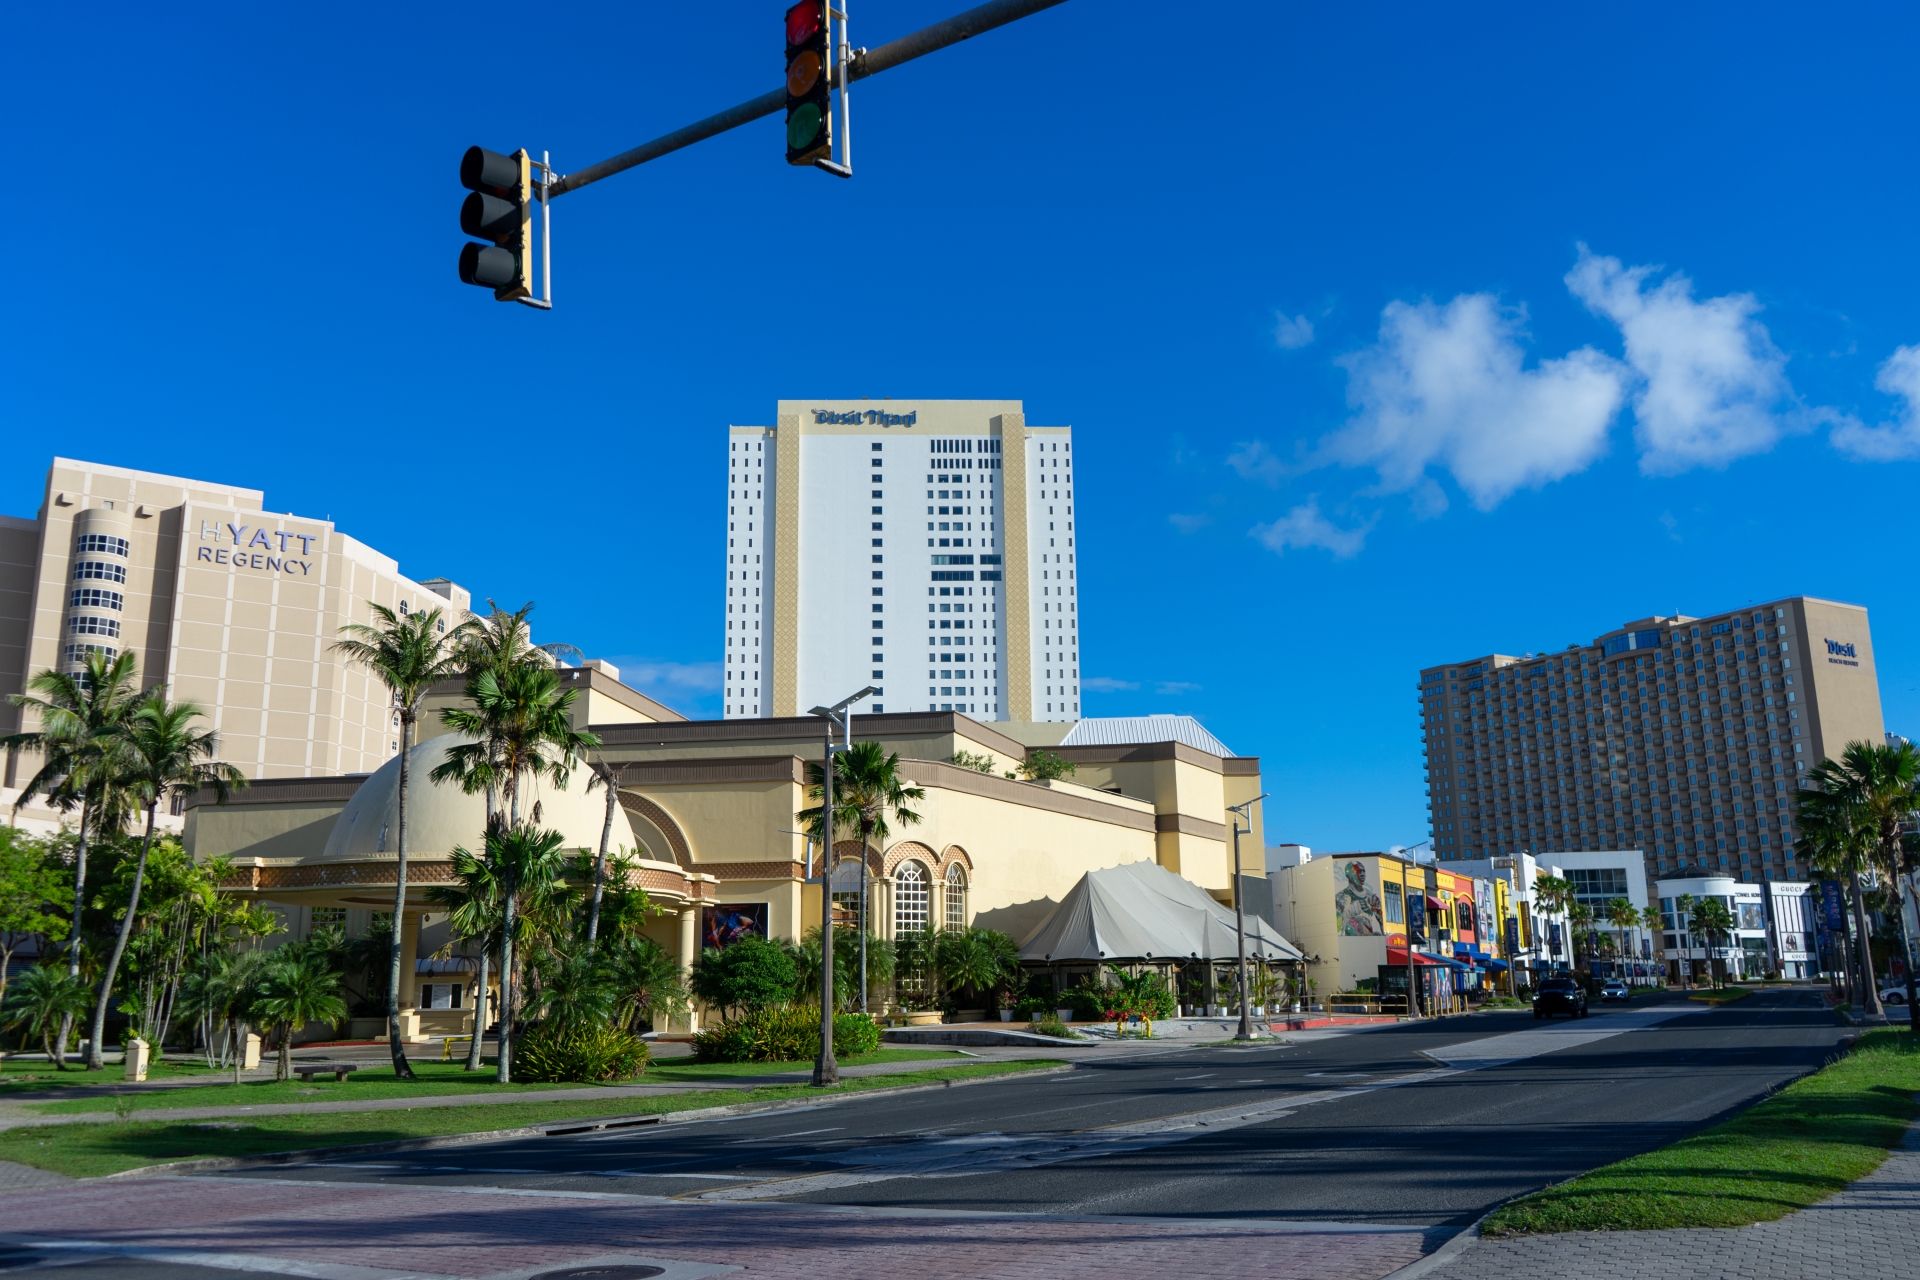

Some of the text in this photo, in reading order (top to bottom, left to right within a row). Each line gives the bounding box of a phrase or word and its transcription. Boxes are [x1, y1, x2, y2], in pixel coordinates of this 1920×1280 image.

[811, 408, 917, 428] Dusit Thani
[201, 519, 317, 555] HYATT
[198, 546, 314, 575] REGENCY
[1824, 638, 1857, 658] Dusit
